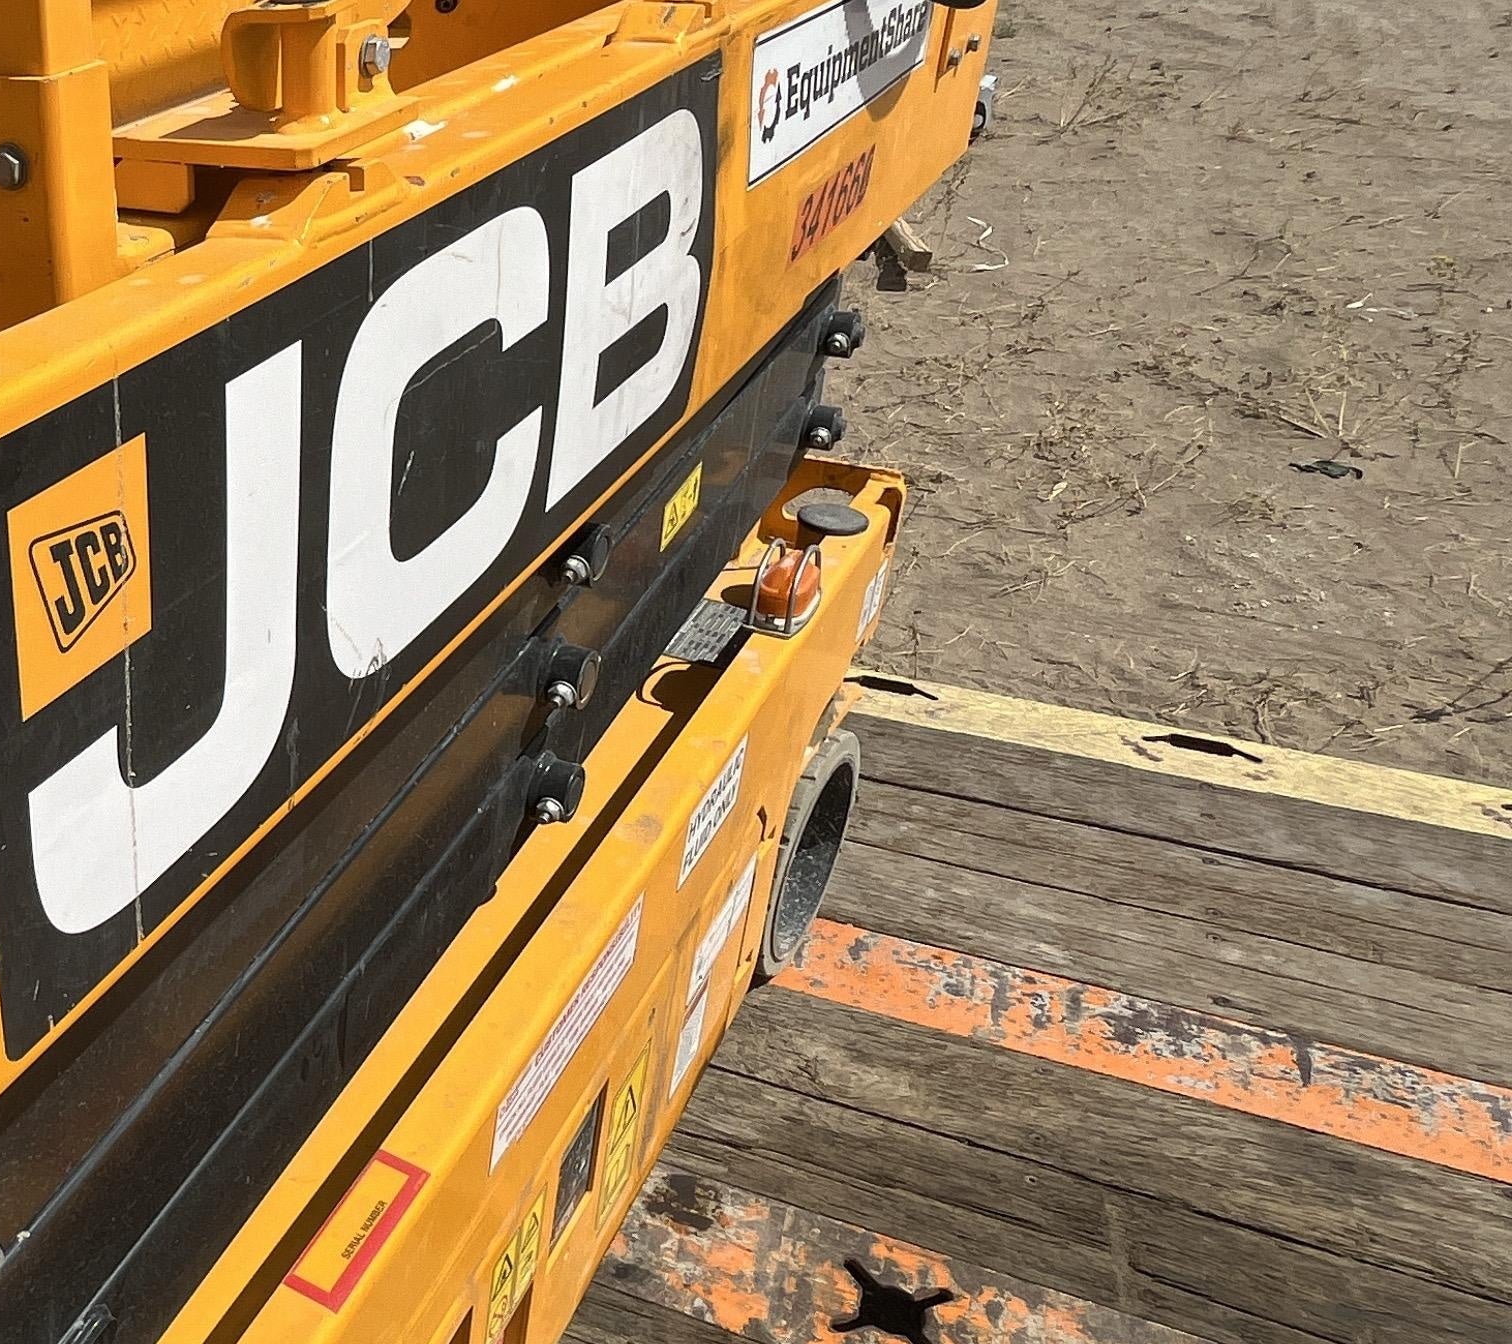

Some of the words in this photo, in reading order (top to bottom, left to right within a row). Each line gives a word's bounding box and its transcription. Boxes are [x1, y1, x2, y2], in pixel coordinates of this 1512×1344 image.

[785, 0, 928, 122] EquipmentShare
[28, 108, 704, 935] JCB
[49, 521, 128, 636] JCB
[341, 1232, 365, 1260] SERIAL
[360, 1199, 388, 1234] NUMBER
